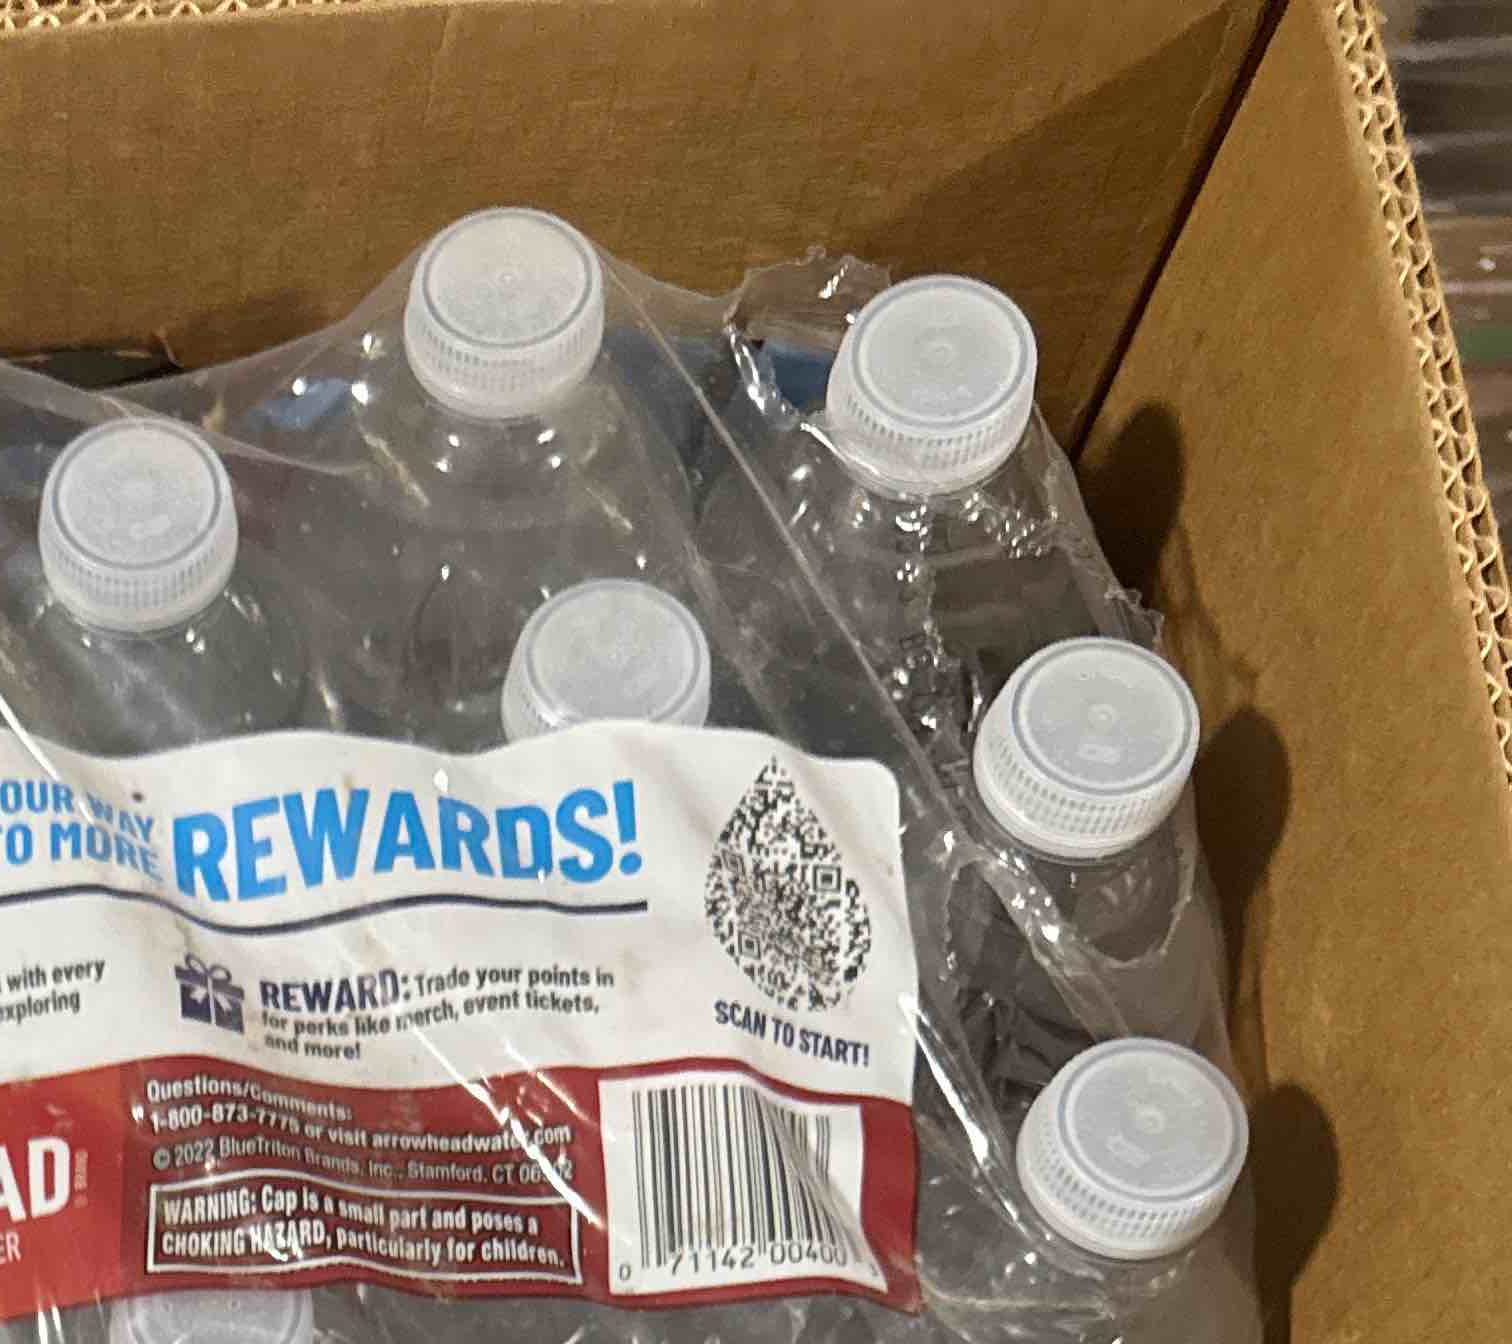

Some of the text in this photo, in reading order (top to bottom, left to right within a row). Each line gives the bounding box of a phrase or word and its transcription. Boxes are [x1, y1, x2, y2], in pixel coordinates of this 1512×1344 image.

[50, 820, 164, 882] MORE
[172, 778, 643, 901] REWARDS!
[6, 967, 48, 993] with
[51, 960, 106, 992] every
[259, 965, 615, 1013] REWARD: Trade your points in
[261, 1010, 288, 1033] for
[293, 1014, 350, 1040] perks
[354, 1014, 391, 1036] like
[463, 992, 520, 1017] event
[525, 989, 600, 1015] tickets,
[714, 999, 872, 1067] SCAN TO START!
[264, 1034, 362, 1060] and more!
[146, 1074, 353, 1122] Questions/Comments:
[619, 1264, 631, 1280] 0
[670, 1246, 755, 1275] 71142
